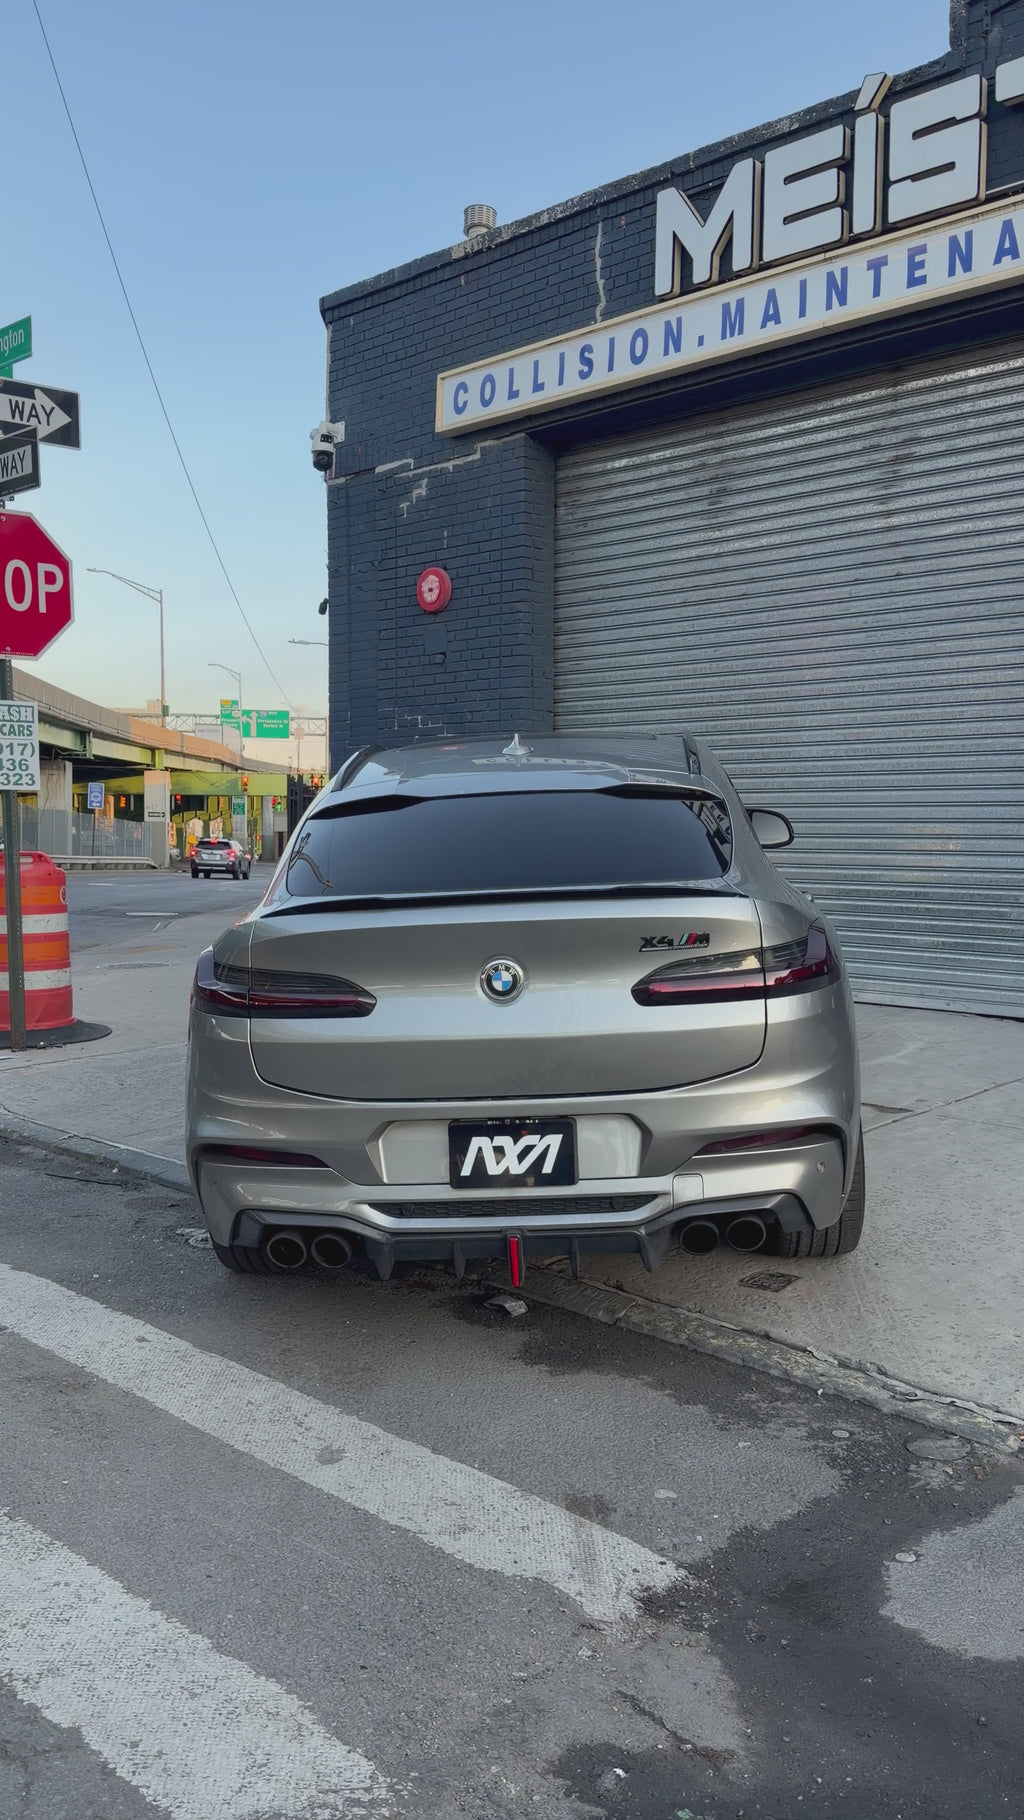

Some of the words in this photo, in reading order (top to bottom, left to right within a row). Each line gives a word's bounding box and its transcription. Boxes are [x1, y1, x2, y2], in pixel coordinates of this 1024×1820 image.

[9, 398, 55, 426] WAY
[0, 450, 26, 479] WAY
[4, 559, 64, 614] OP
[0, 723, 33, 737] CARS
